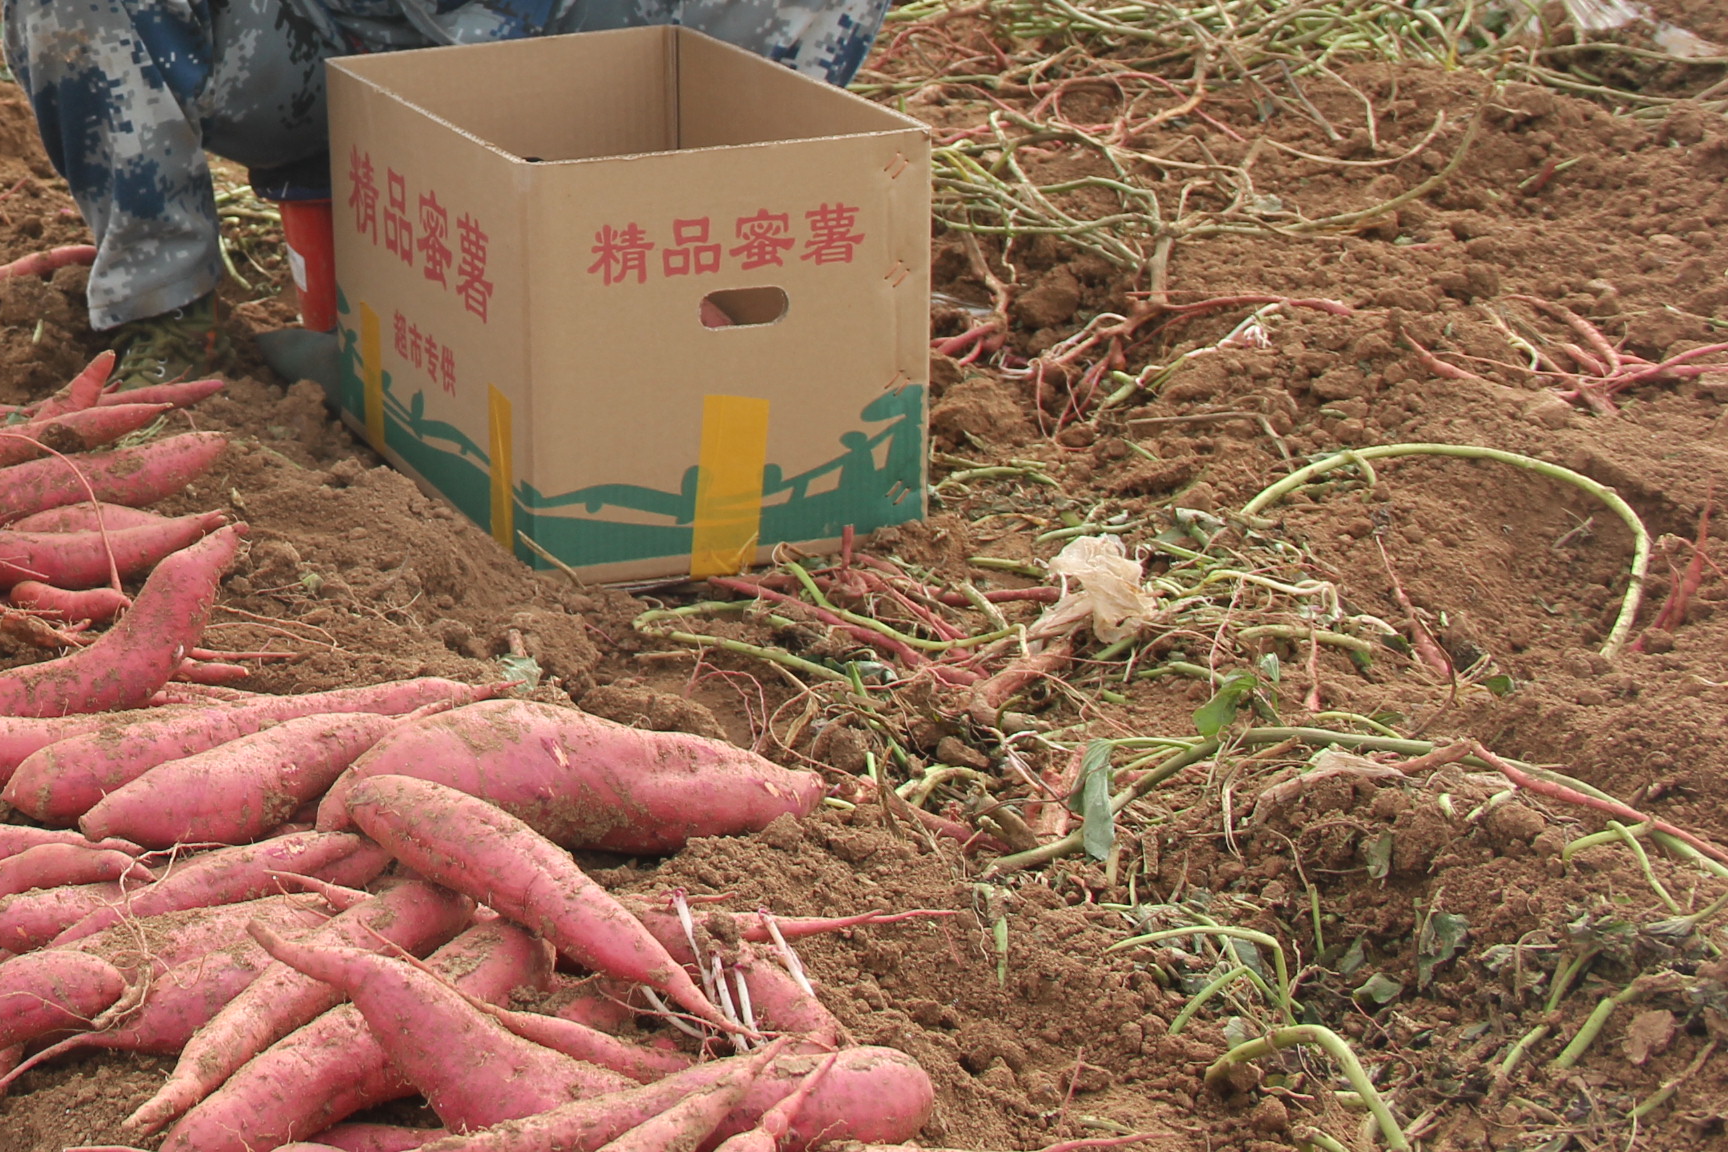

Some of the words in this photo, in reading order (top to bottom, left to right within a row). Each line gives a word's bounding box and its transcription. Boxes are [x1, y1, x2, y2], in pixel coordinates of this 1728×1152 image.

[349, 144, 494, 325] 精品蜜薯
[586, 201, 866, 286] 精品蜜薯
[393, 308, 456, 398] 超市专供
